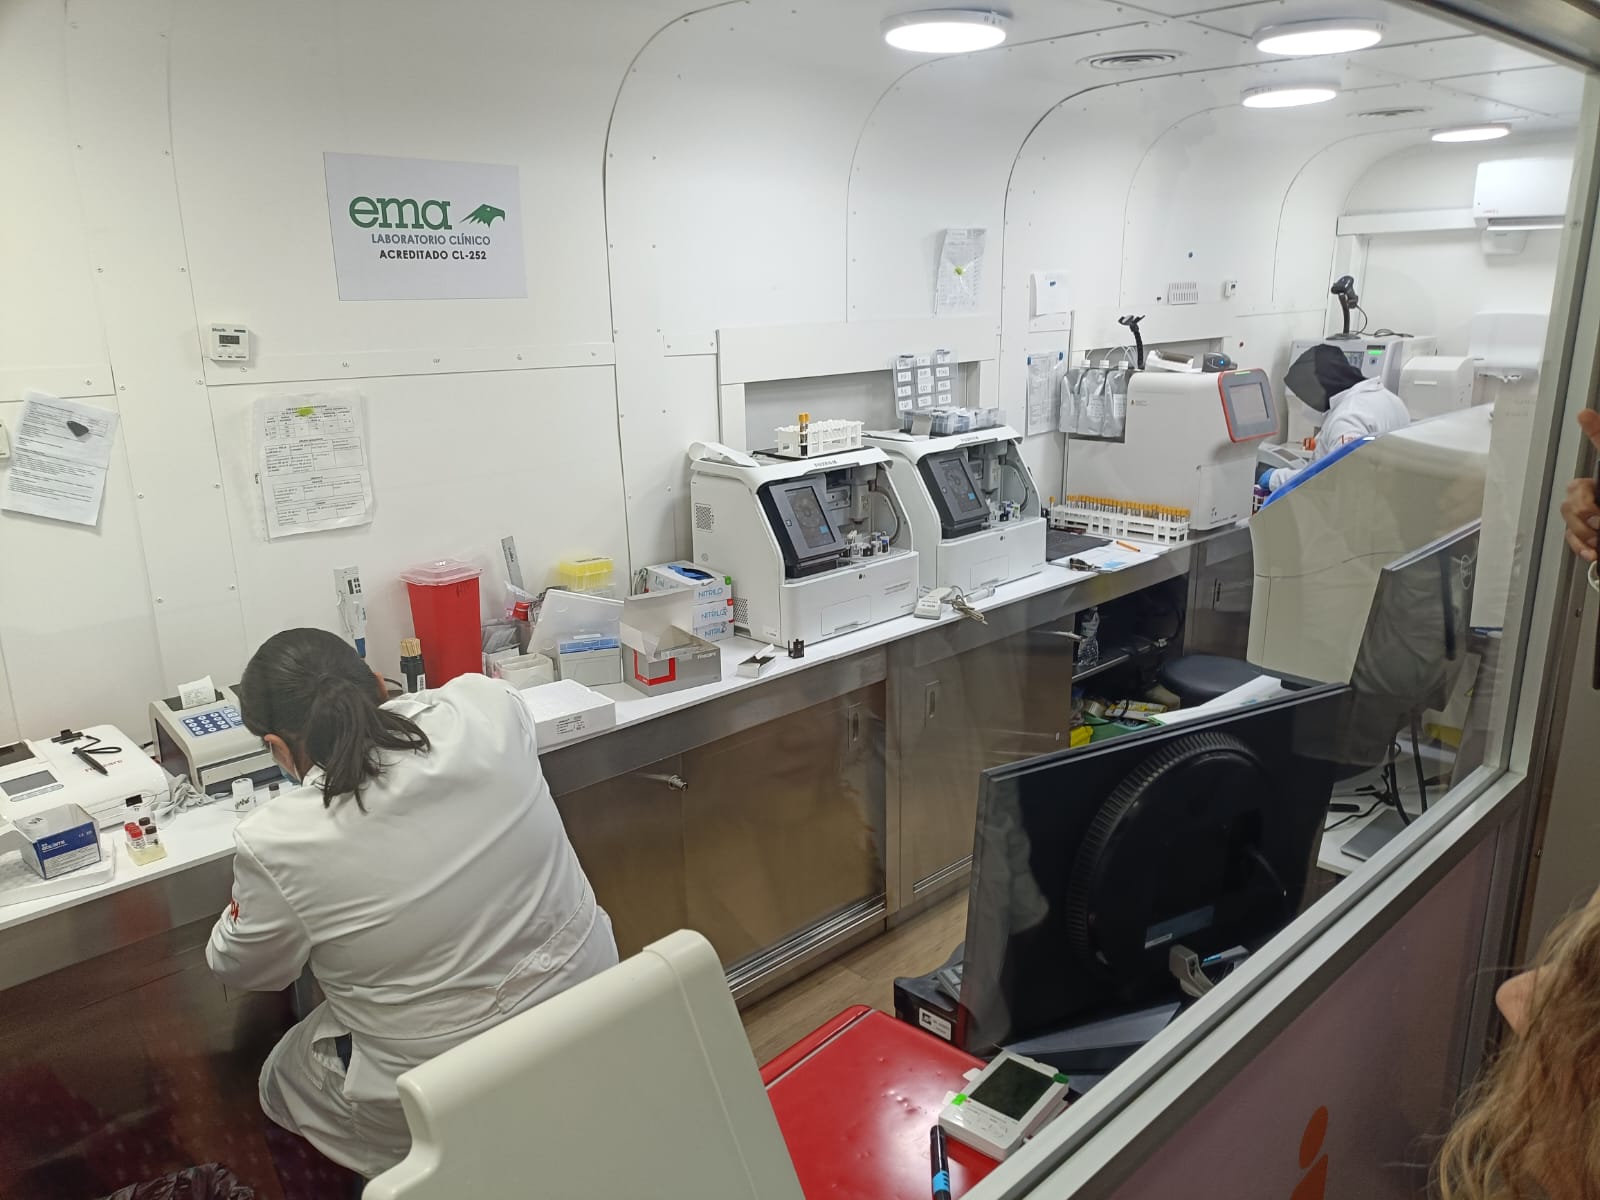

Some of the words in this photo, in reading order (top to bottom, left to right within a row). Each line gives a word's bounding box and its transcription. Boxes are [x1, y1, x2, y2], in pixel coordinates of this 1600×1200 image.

[349, 196, 452, 230] ema
[371, 233, 446, 245] LABORATORIO
[449, 233, 490, 246] CLÍNICO
[379, 249, 448, 260] ACREDITADO
[452, 250, 487, 260] CL-252
[698, 587, 723, 598] NITRILO
[702, 608, 727, 618] NITRILO
